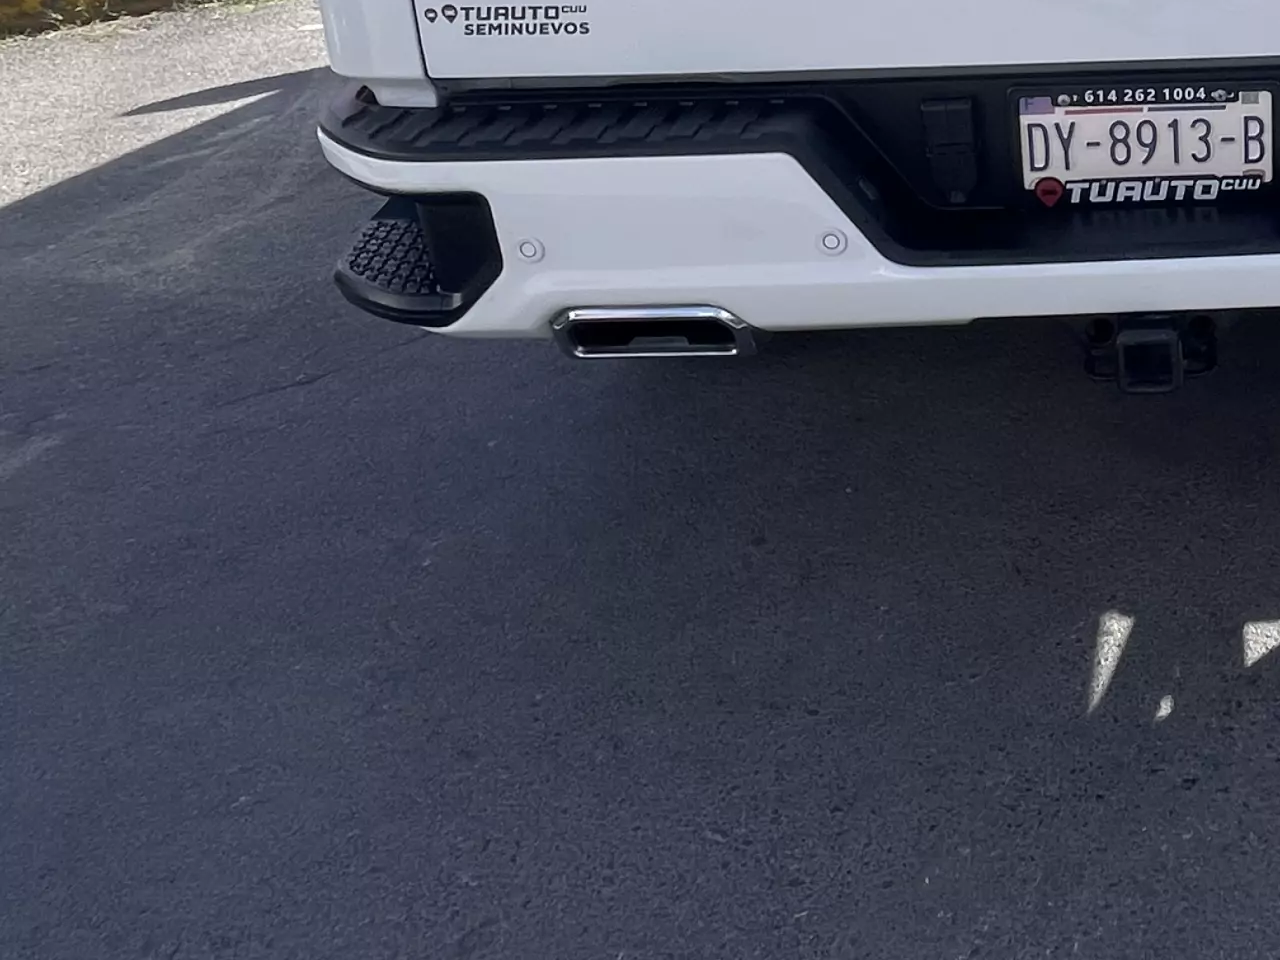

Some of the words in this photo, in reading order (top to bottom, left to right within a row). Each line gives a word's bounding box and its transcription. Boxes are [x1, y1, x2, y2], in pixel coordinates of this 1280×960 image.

[464, 22, 590, 36] SEMINUEVOS
[1084, 90, 1118, 102] 614
[1123, 89, 1157, 102] 262
[1162, 87, 1206, 101] 1004
[1027, 116, 1266, 172] DY-8913-B
